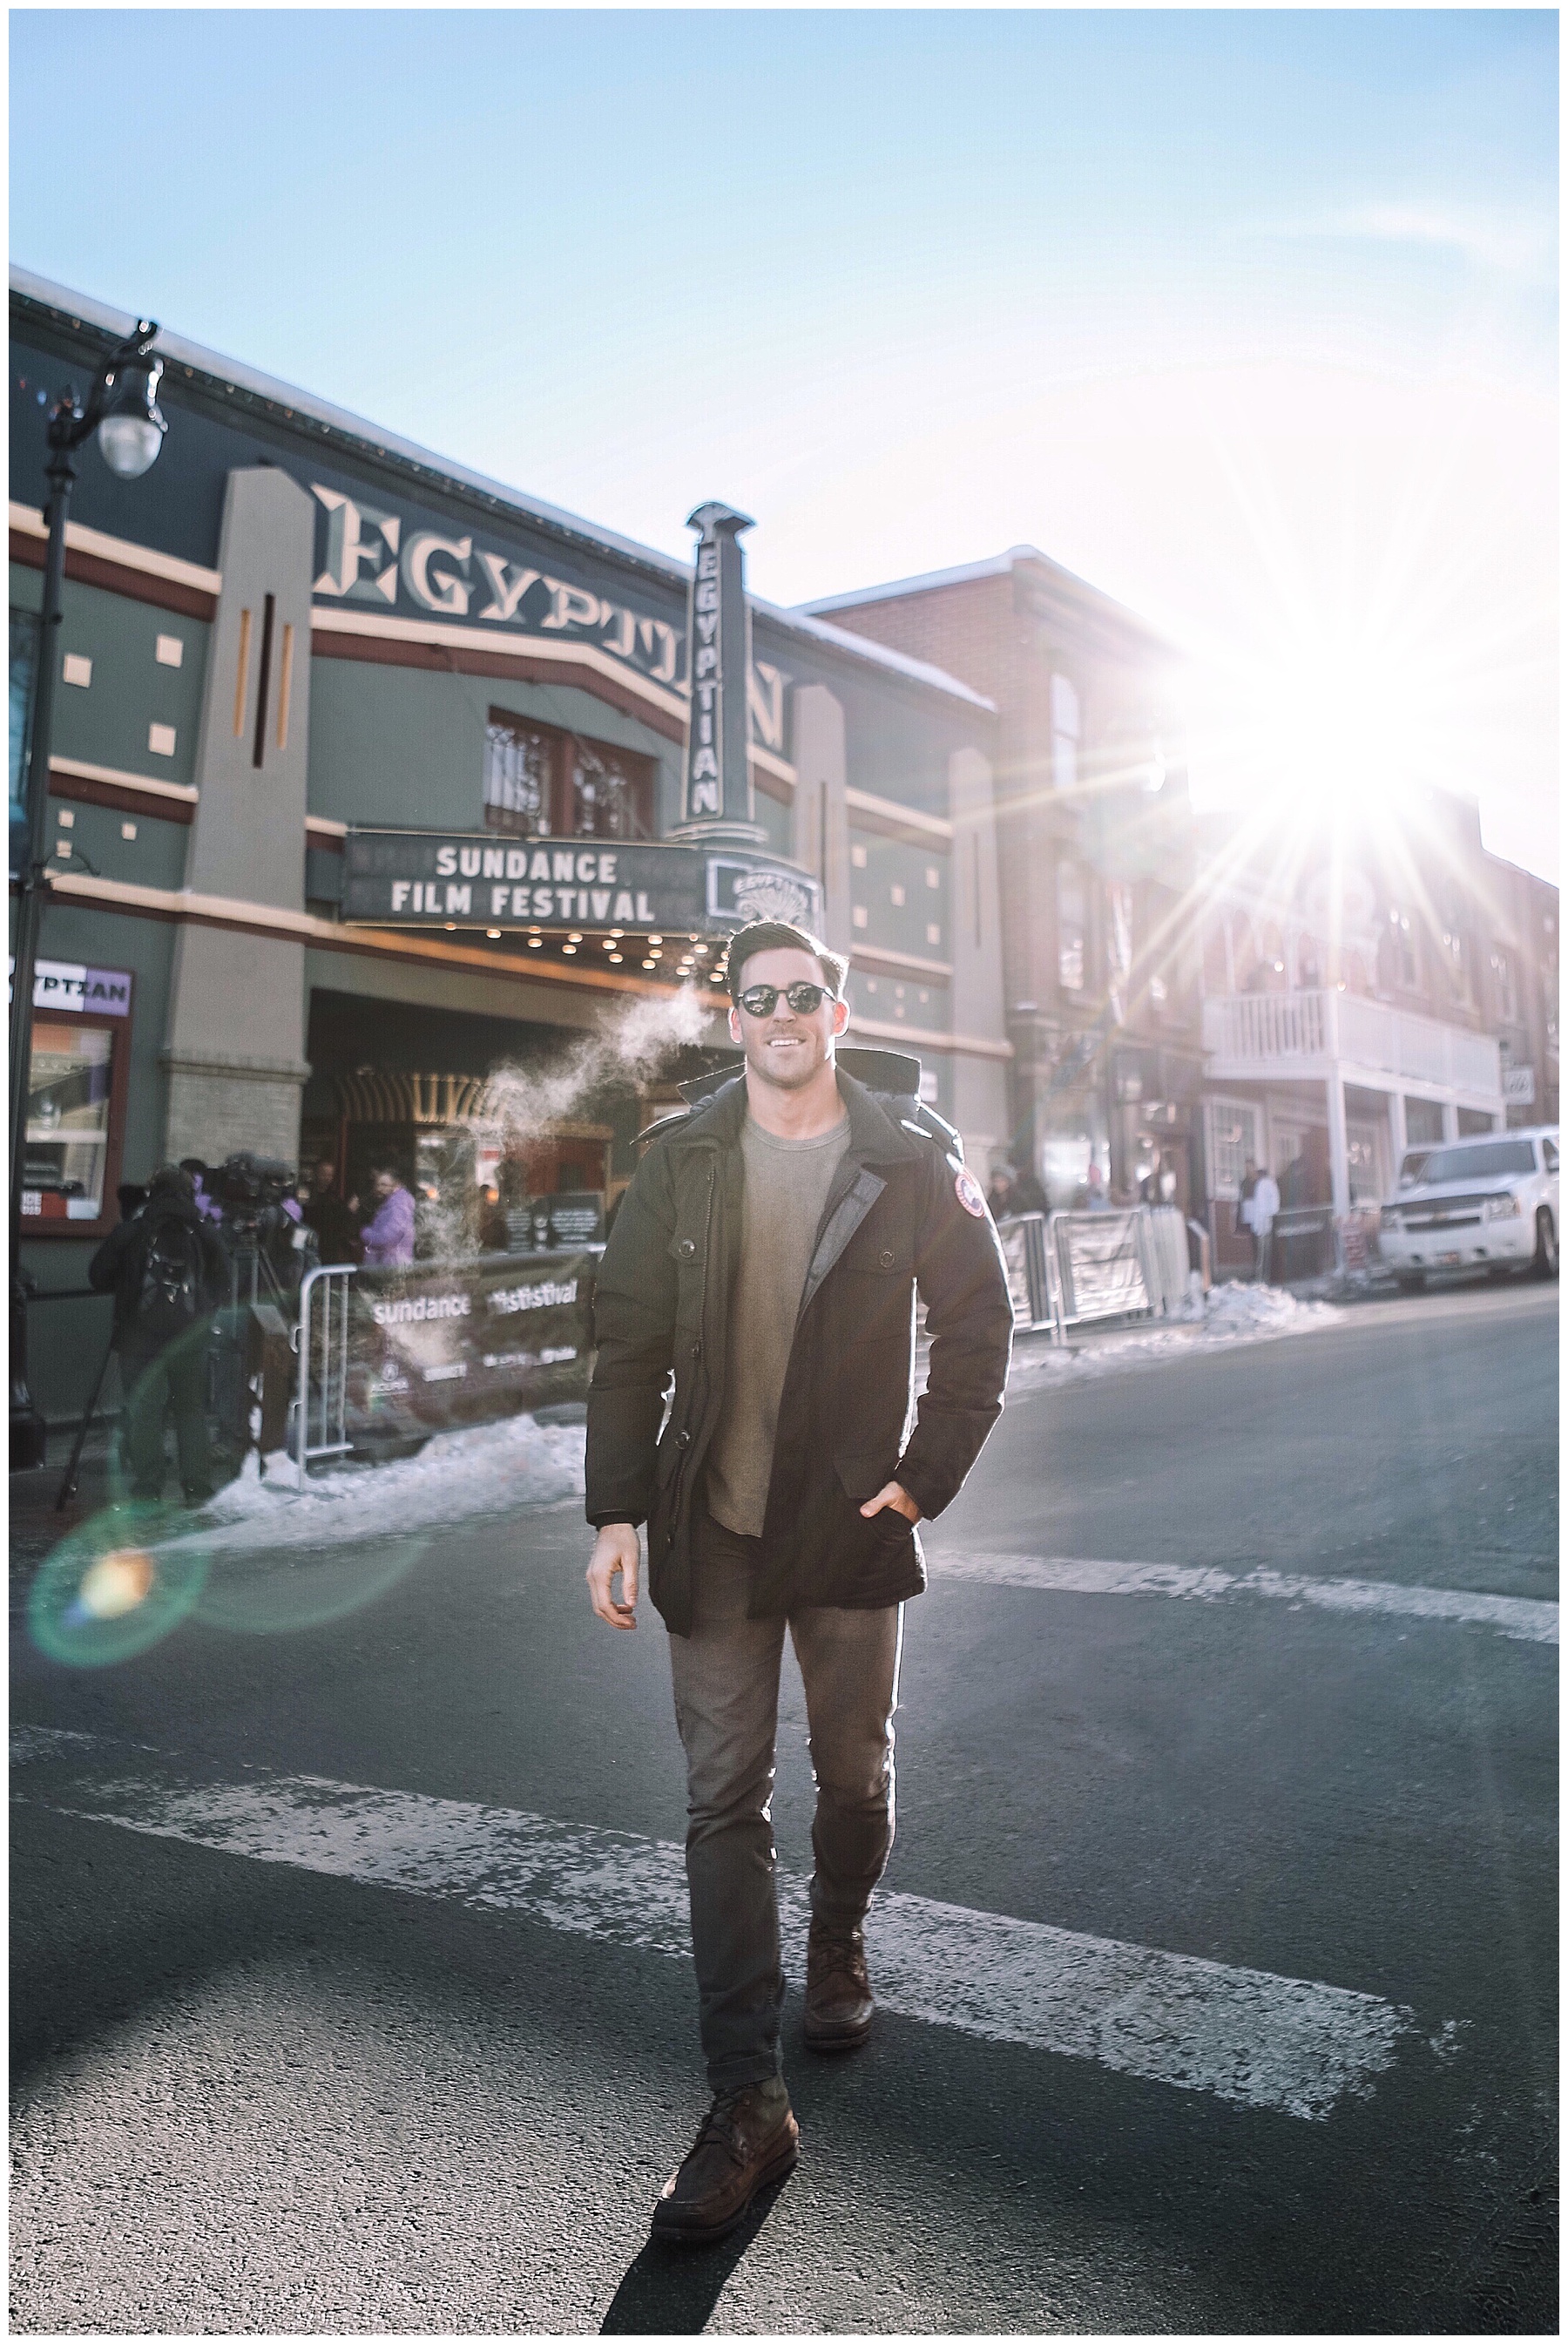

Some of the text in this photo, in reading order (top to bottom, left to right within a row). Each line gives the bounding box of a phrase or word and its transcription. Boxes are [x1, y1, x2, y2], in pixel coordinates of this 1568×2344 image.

[311, 482, 789, 750] EGYPTIN
[693, 545, 720, 815] EGYPTIAN
[436, 845, 618, 884] SUNDANCE
[391, 880, 656, 923] FILM FESTIVAL
[372, 1294, 471, 1324] sundance
